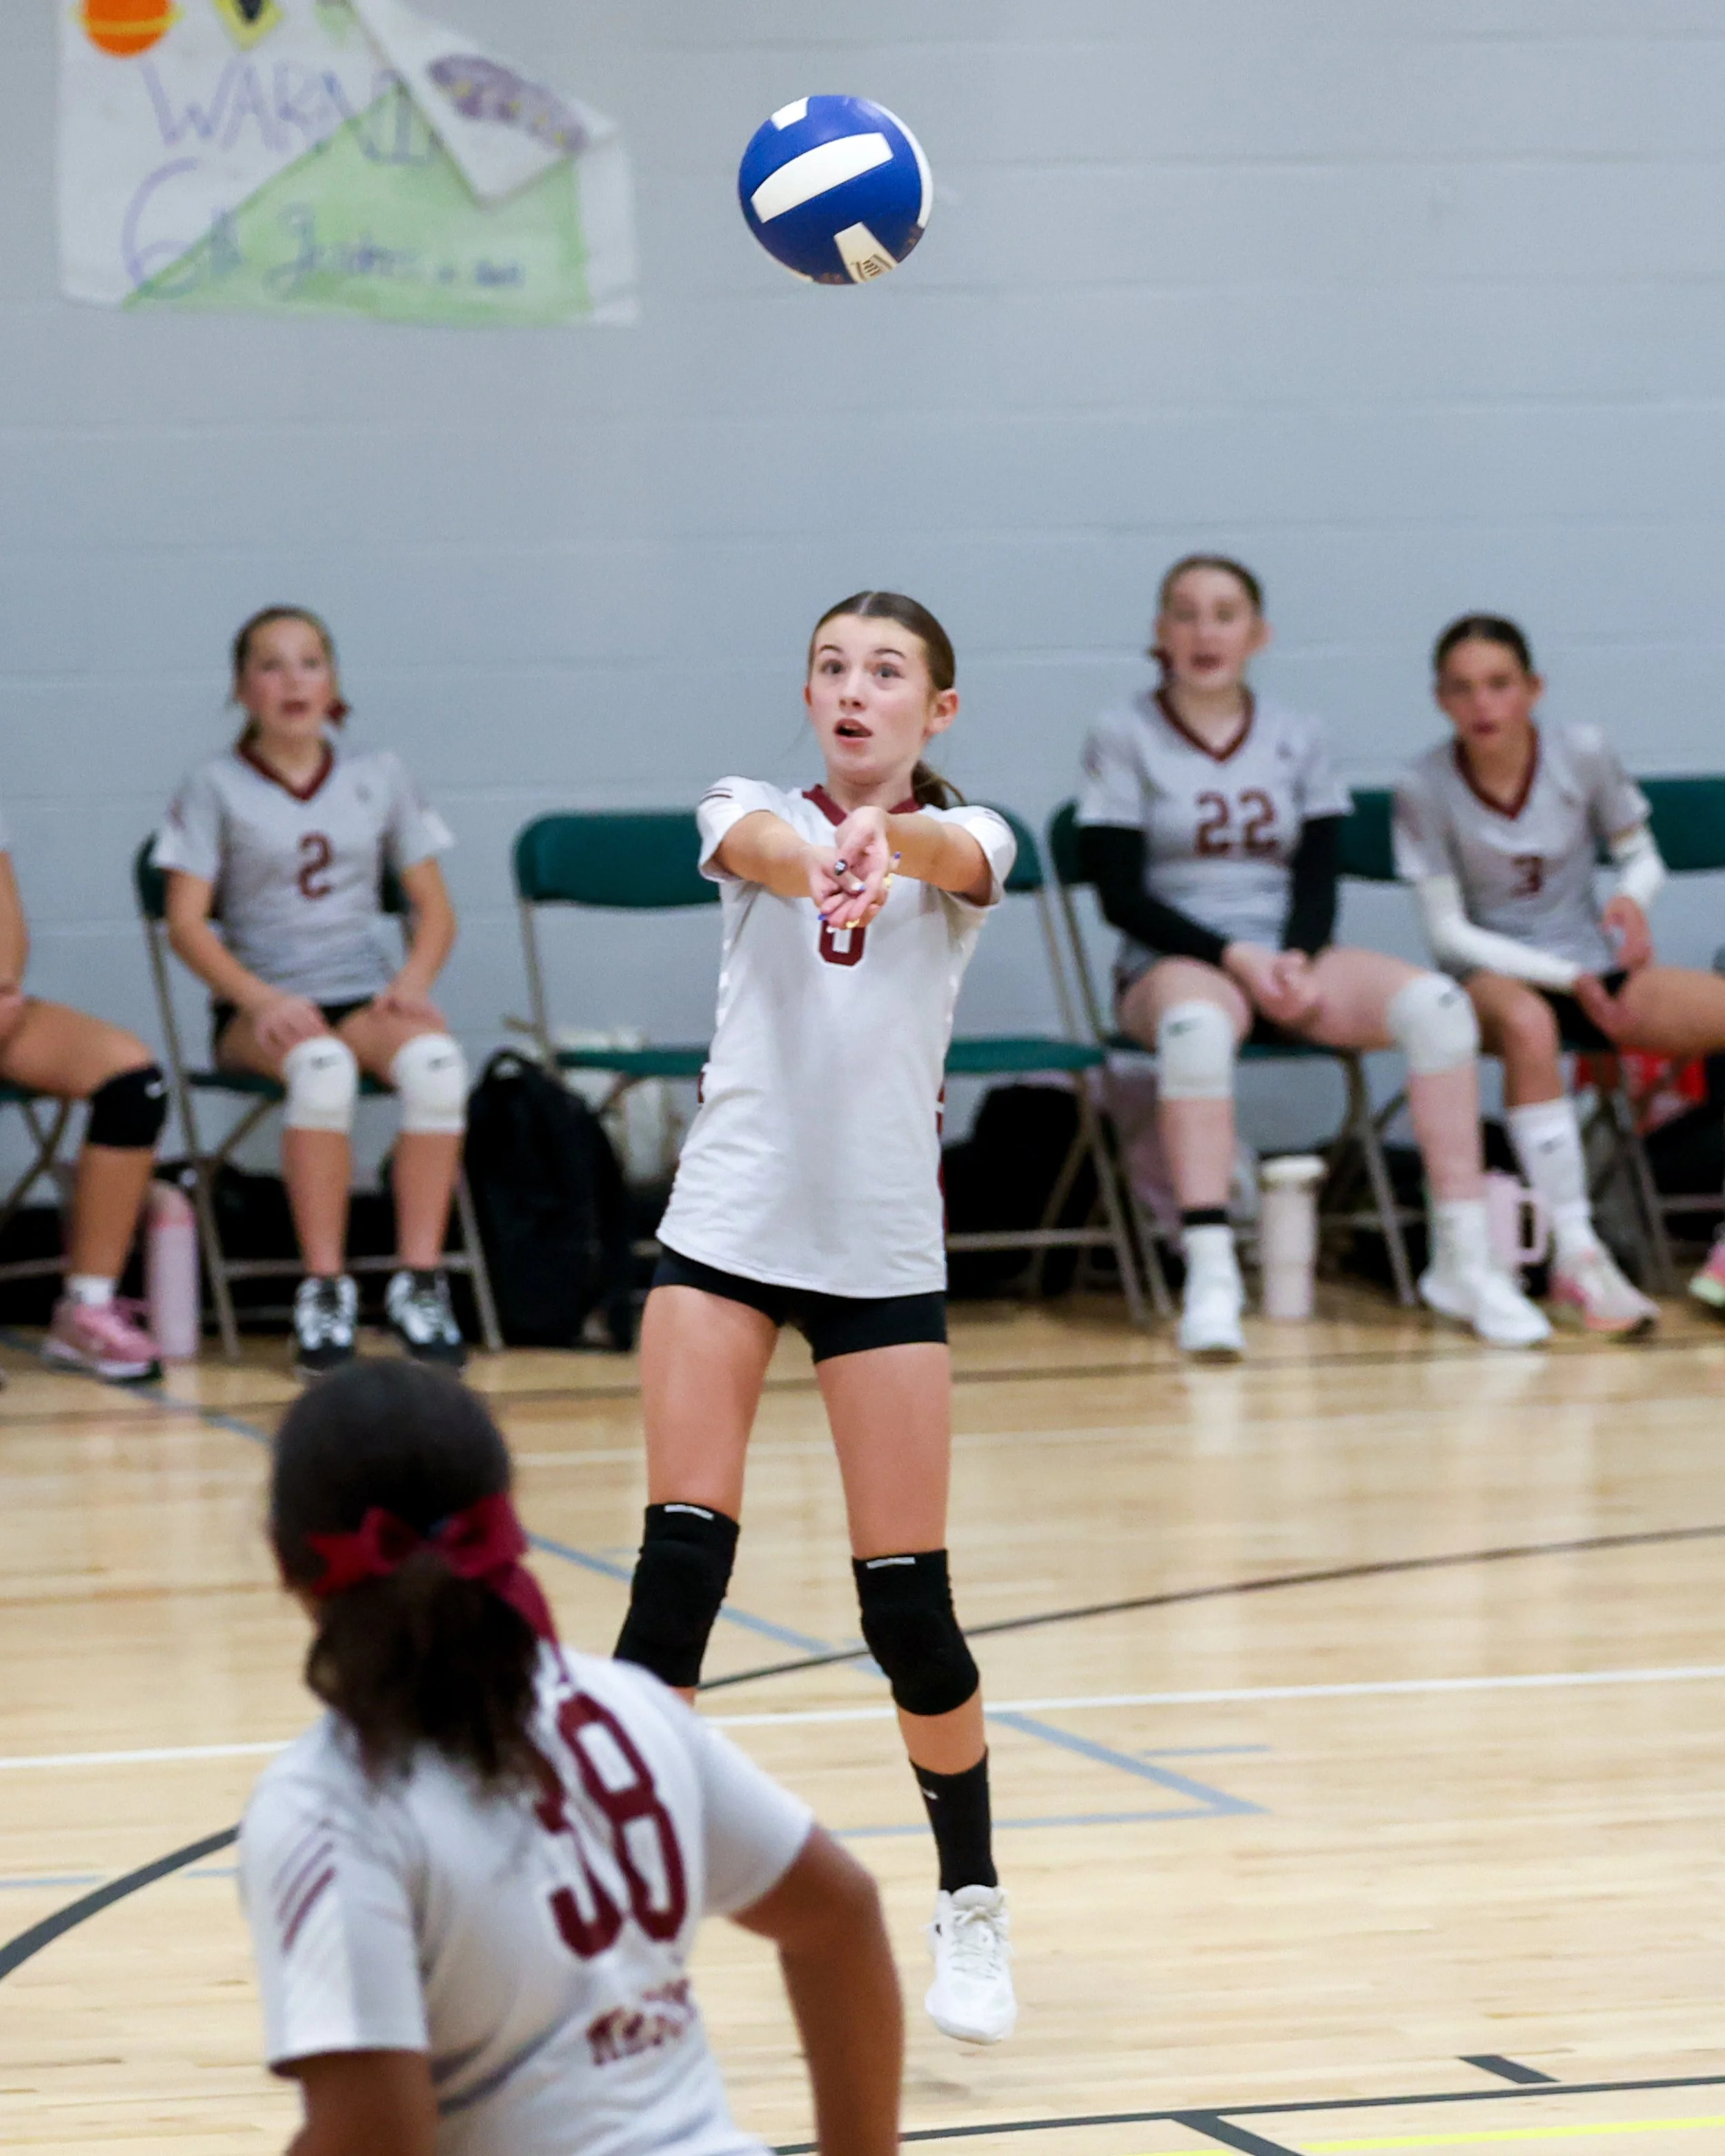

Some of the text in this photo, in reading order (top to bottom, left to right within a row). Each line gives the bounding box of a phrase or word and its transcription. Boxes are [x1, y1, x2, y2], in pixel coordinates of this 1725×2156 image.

[1195, 791, 1276, 858] 22
[297, 831, 333, 900] 2
[1509, 856, 1544, 898] 3
[534, 1692, 687, 1959] 38
